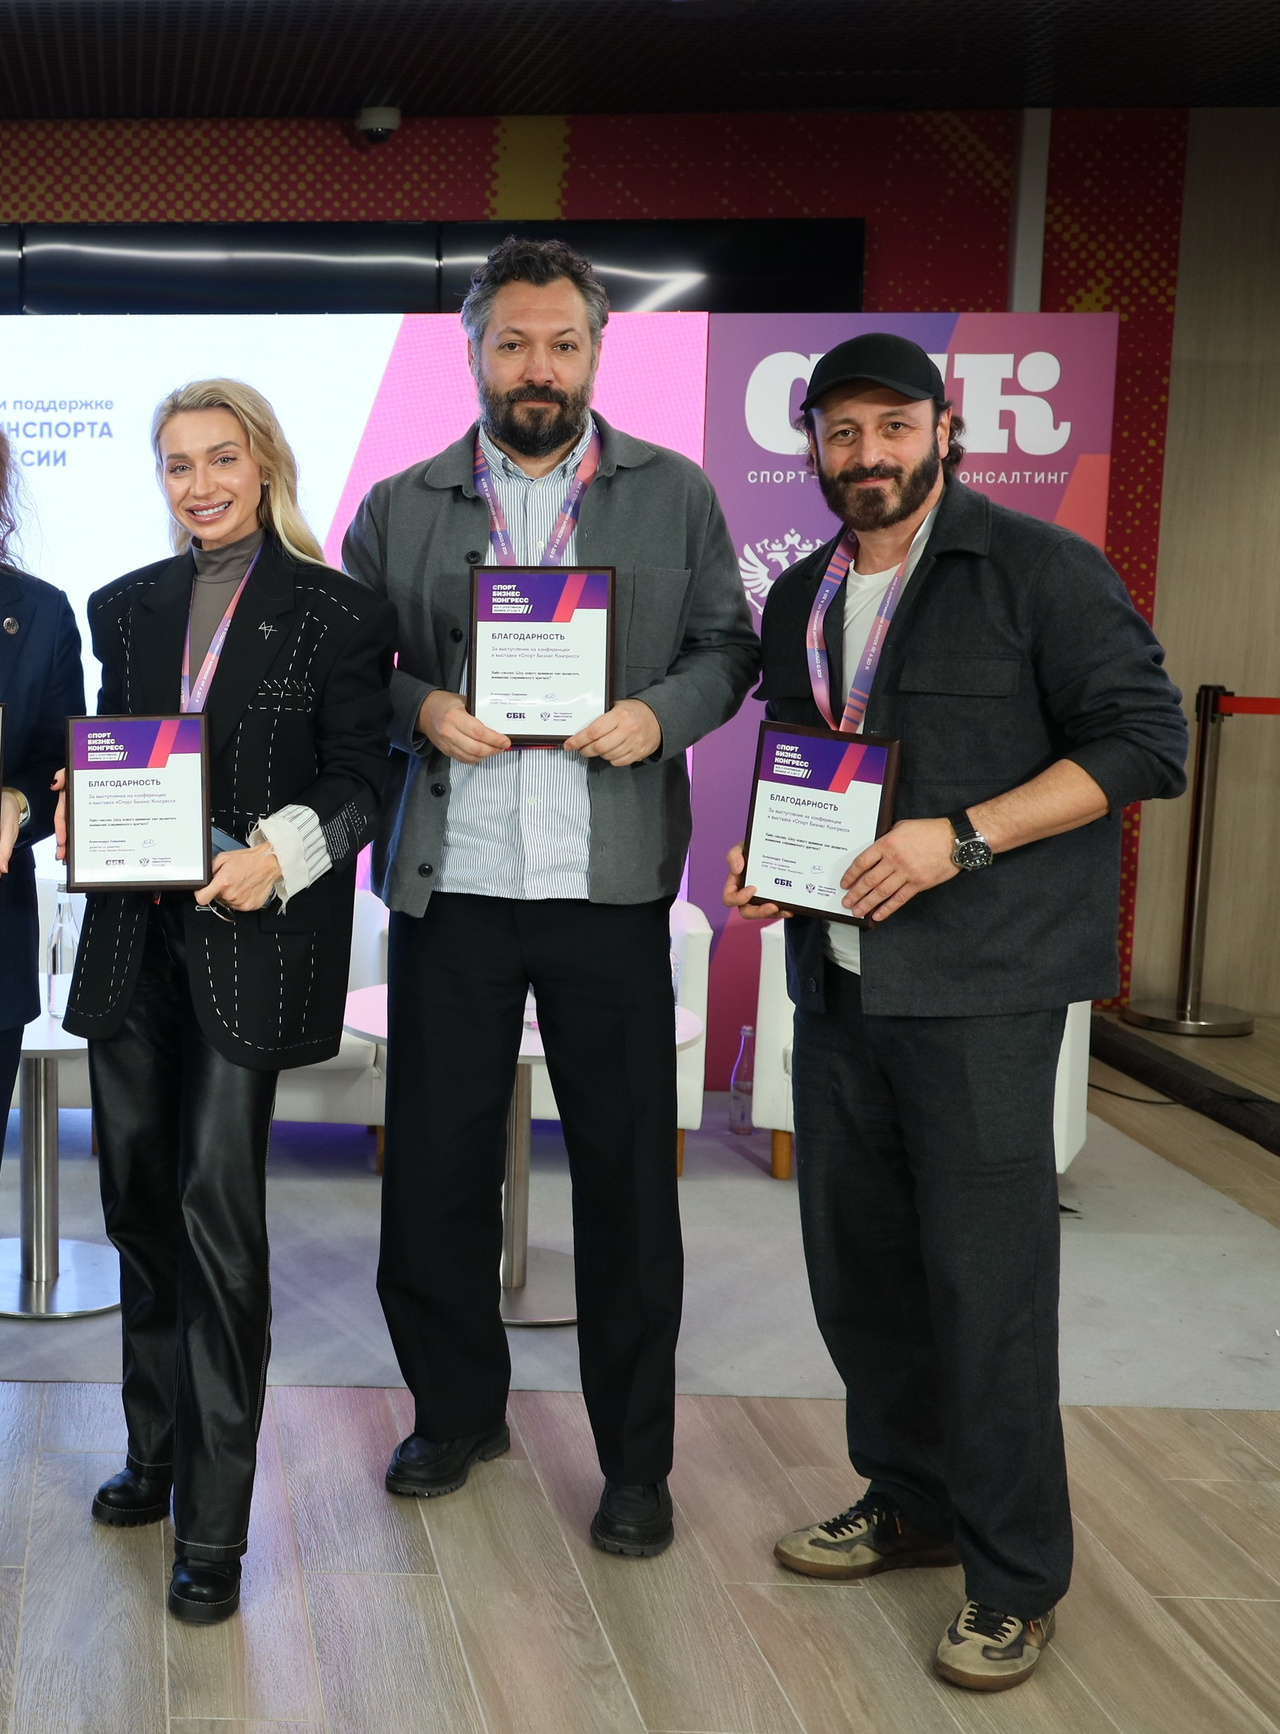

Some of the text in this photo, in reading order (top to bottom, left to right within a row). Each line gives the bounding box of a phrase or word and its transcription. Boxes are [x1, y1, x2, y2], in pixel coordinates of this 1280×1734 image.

[13, 399, 114, 413] поддержке
[745, 351, 1071, 456] СК
[1, 421, 114, 439] НСПОРТА
[747, 471, 807, 484] СПОРТ
[958, 471, 1070, 485] ОНСАЛТИНГ
[491, 632, 565, 641] БЛАГОДАРНОСТЬ
[776, 743, 799, 752] СПОРТ
[775, 749, 801, 759] БИЗНЕС
[774, 756, 809, 767] КОНГРЕСС
[88, 779, 161, 788] БЛАГОДАРНОСТЬ
[769, 793, 839, 813] БЛАГОДАРНОСТЬ
[773, 877, 792, 887] СБК
